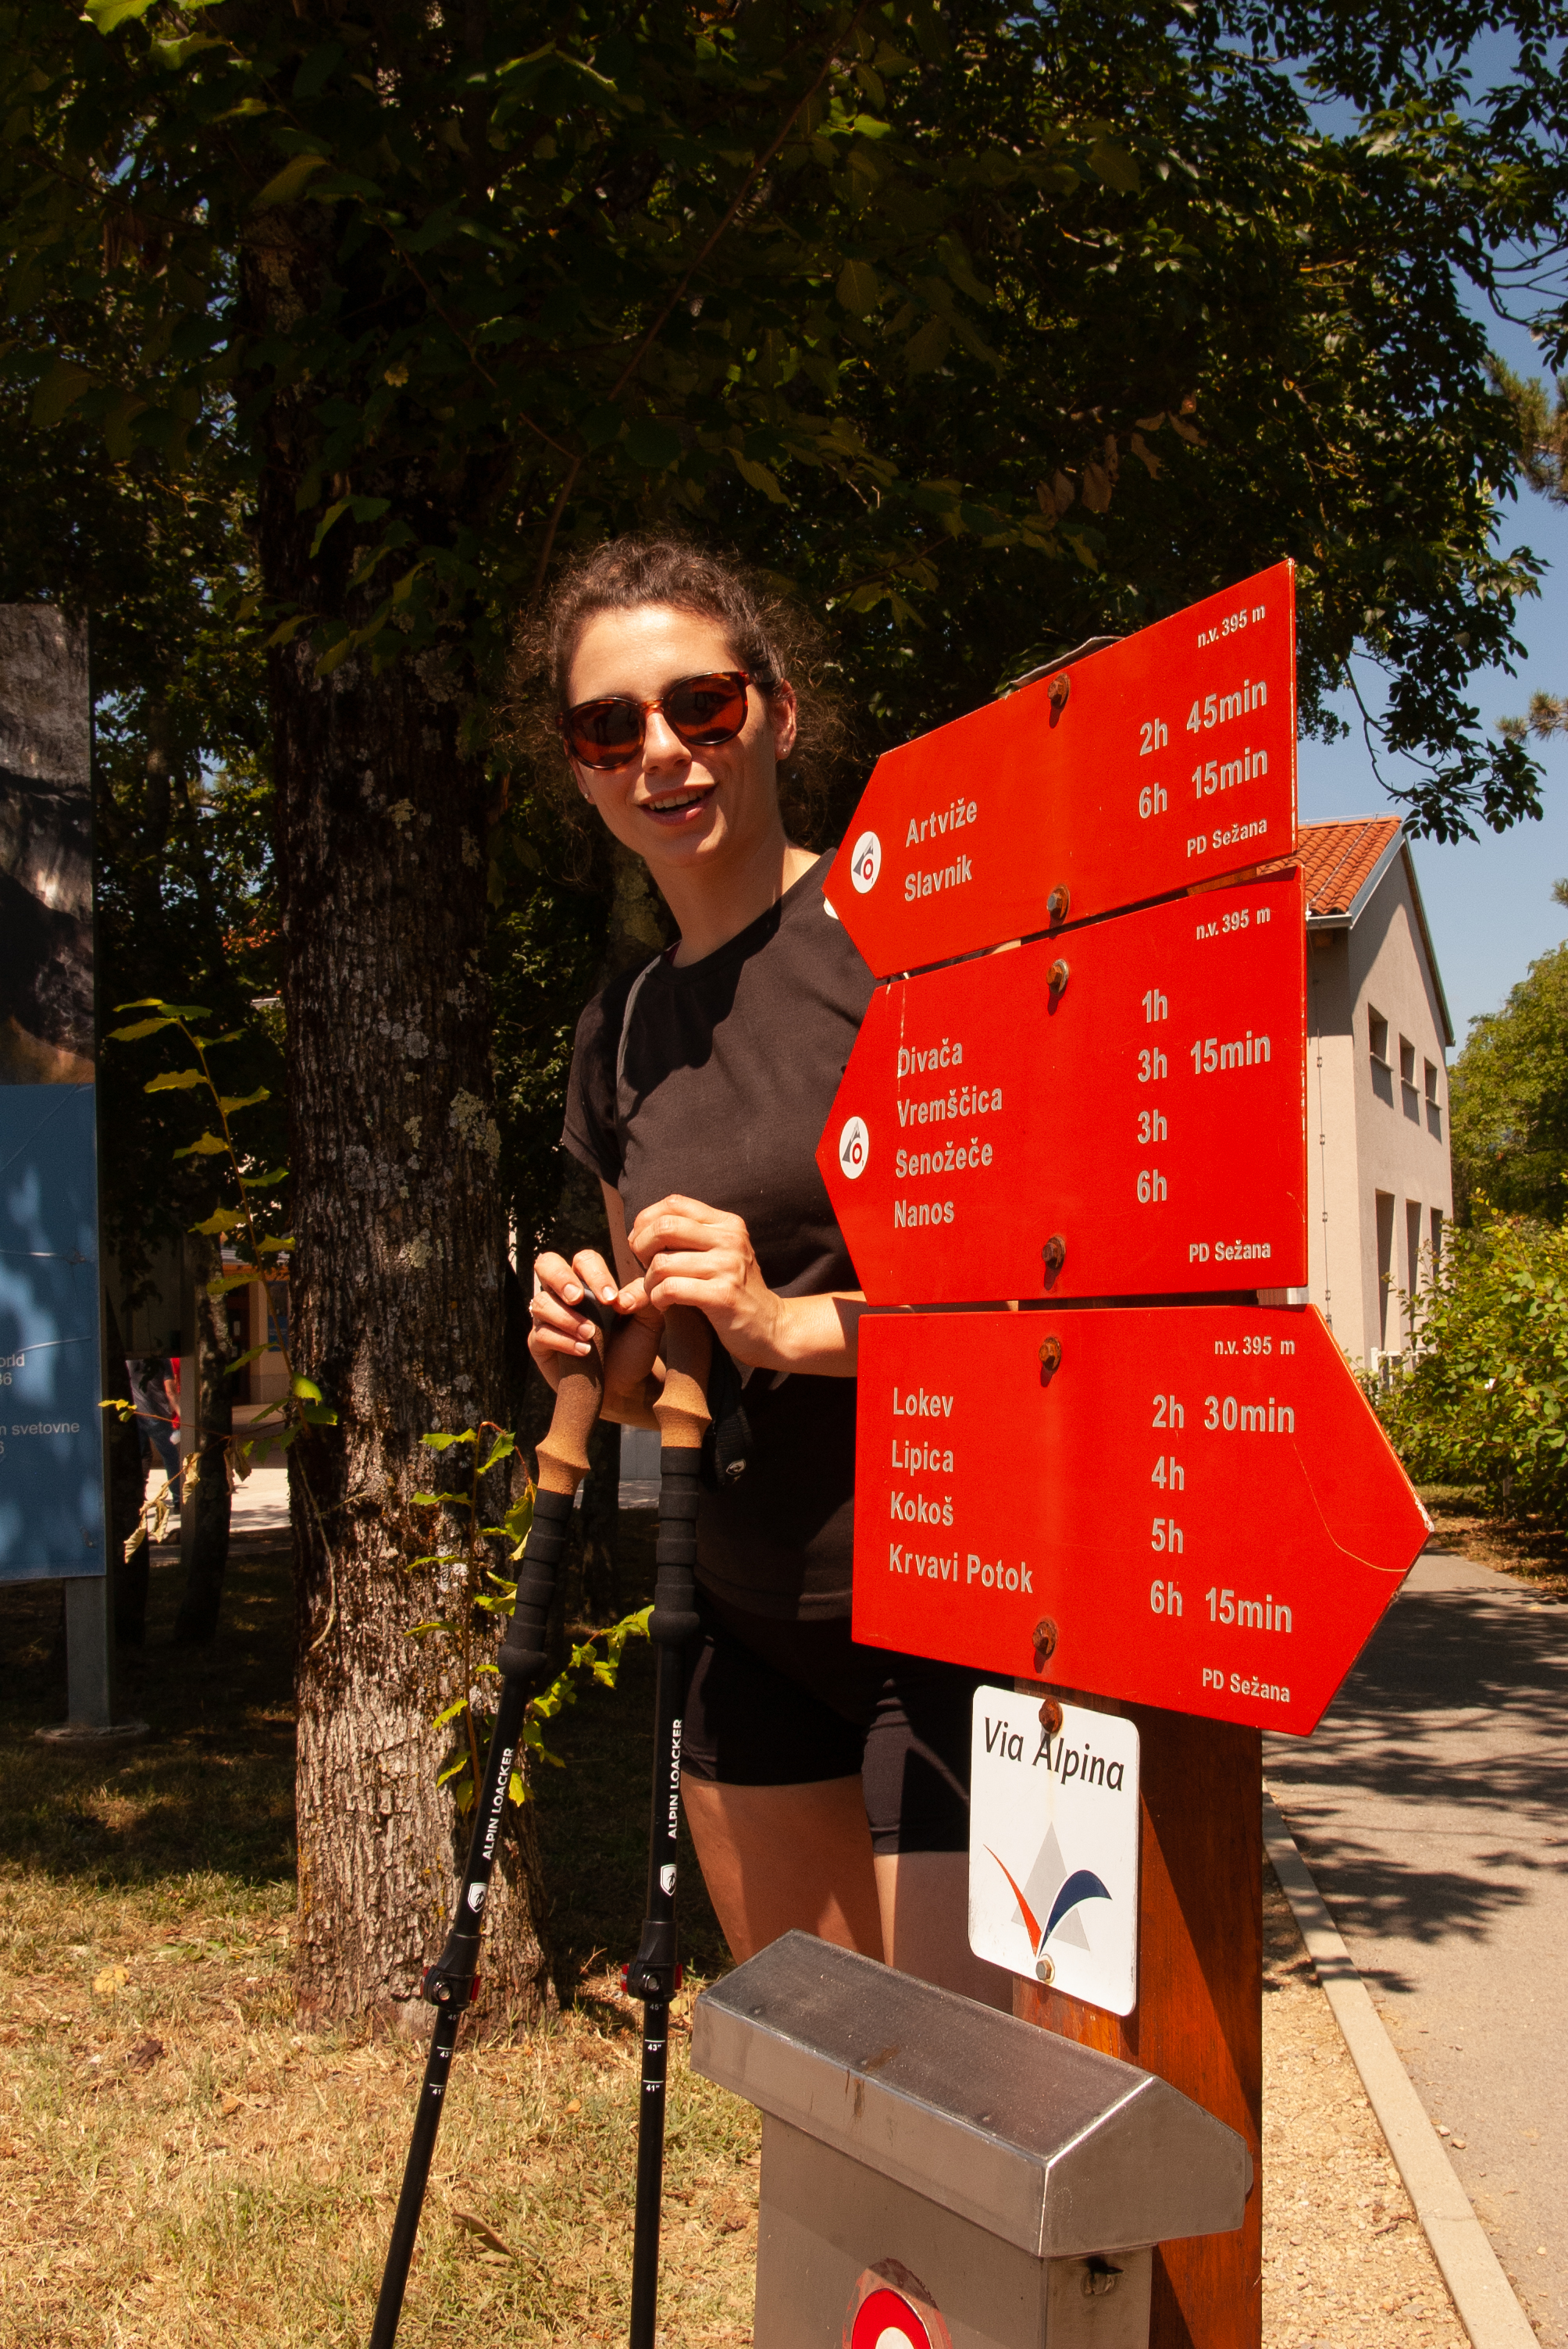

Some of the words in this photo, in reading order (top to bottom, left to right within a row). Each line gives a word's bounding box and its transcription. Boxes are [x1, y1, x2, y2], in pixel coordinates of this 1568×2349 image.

[1198, 627, 1220, 648] n.v.
[1222, 609, 1248, 636] 395
[1252, 604, 1266, 623] m
[1139, 718, 1168, 756] 2h
[1186, 679, 1267, 734] 45min
[1139, 782, 1167, 819] 6h
[1192, 747, 1268, 799] 15min
[905, 797, 978, 848] Artviže
[1187, 835, 1207, 857] PD
[1212, 818, 1267, 849] Sežana
[904, 854, 972, 902] Slavnik
[1196, 921, 1219, 940] n.v.
[1222, 911, 1250, 933] 395
[1256, 907, 1270, 925] m
[1142, 988, 1168, 1024] 1h
[897, 1038, 963, 1079] Divača
[1137, 1046, 1167, 1082] 3h
[1190, 1030, 1270, 1075] 15min
[896, 1085, 1003, 1128] Vremščica
[1137, 1109, 1167, 1144] 3h
[895, 1136, 993, 1178] Senožeče
[1137, 1169, 1167, 1203] 6h
[894, 1199, 954, 1228] Nanos
[1189, 1242, 1210, 1263] PD
[1214, 1239, 1271, 1261] Sežana
[1214, 1336, 1239, 1355] n.v.
[1242, 1335, 1272, 1355] 395
[1280, 1340, 1295, 1355] m
[893, 1387, 954, 1417] Lokev
[1152, 1394, 1185, 1428] 2h
[1204, 1395, 1295, 1433] 30min
[12, 1422, 80, 1435] svetovne
[892, 1439, 953, 1477] Lipica
[1151, 1456, 1185, 1491] 4h
[890, 1491, 953, 1527] Kokoš
[1151, 1517, 1184, 1554] 5h
[889, 1543, 958, 1582] Krvavi
[967, 1553, 1033, 1594] Potok
[1150, 1580, 1183, 1616] 6h
[1205, 1587, 1292, 1633] 15min
[1203, 1667, 1224, 1690] PD
[1230, 1673, 1290, 1703] Sežana
[670, 1719, 682, 1789] LOACKER
[984, 1717, 1023, 1762] Via
[1032, 1733, 1124, 1791] Alpina
[482, 1817, 499, 1860] ALPIN
[491, 1748, 514, 1813] LOACKER
[668, 1795, 679, 1839] ALPIN
